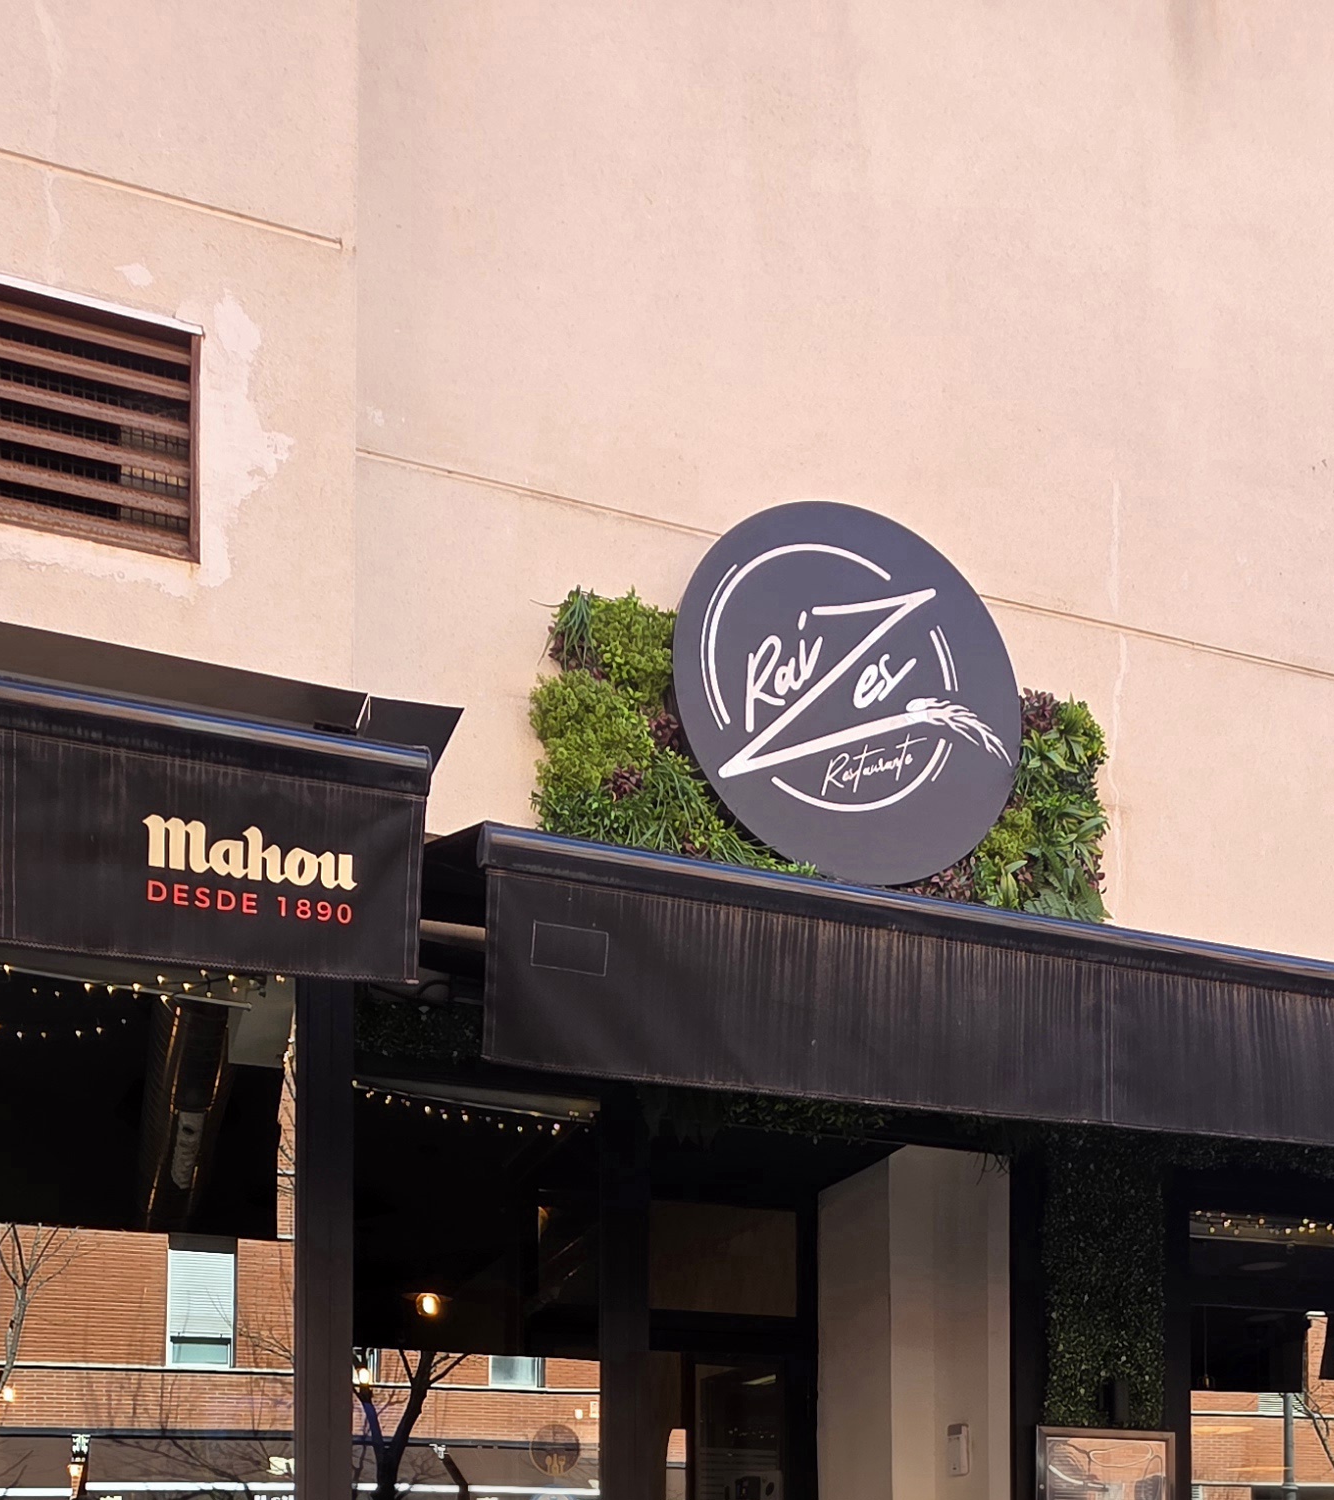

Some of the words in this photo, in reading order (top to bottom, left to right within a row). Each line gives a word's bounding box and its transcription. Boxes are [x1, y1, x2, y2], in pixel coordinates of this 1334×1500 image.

[143, 813, 358, 891] Mahou
[146, 879, 258, 915] DESDE
[276, 895, 353, 926] 1890
